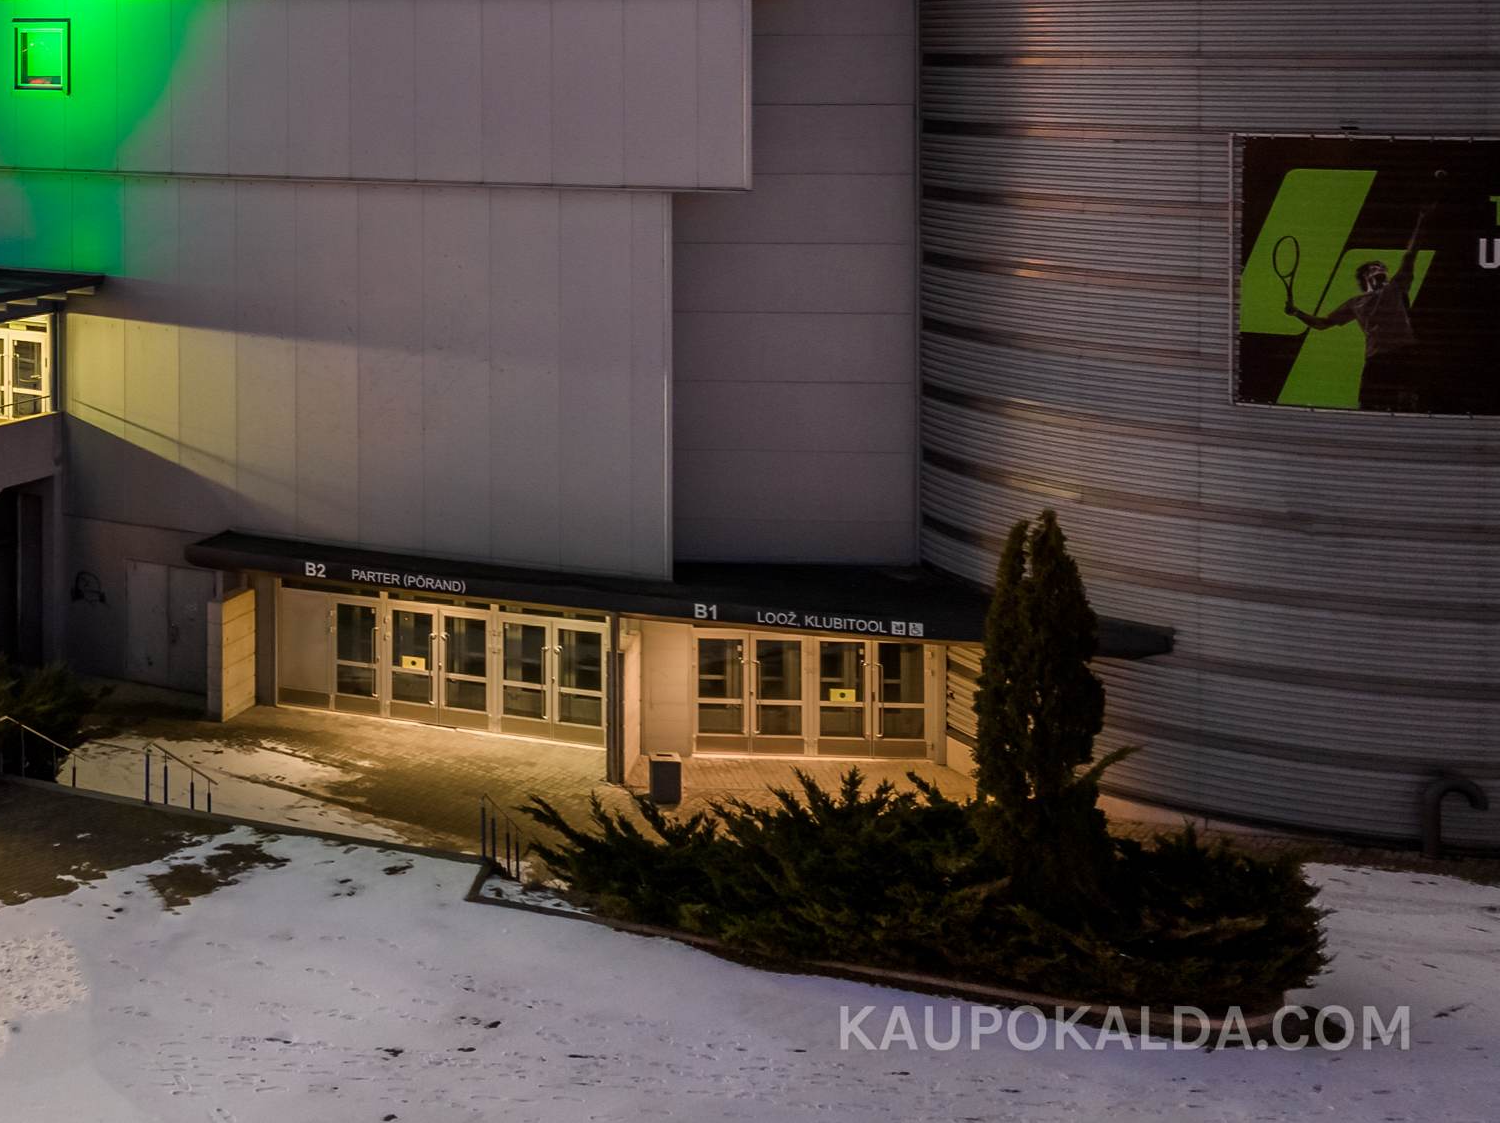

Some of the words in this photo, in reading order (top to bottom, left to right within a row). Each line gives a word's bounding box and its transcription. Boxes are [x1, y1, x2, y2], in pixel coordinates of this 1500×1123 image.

[304, 561, 327, 578] B2
[351, 568, 401, 586] PARTER
[403, 573, 467, 594] (PÕRAND)
[693, 603, 718, 620] B1
[804, 614, 888, 634] KLUBITOOL
